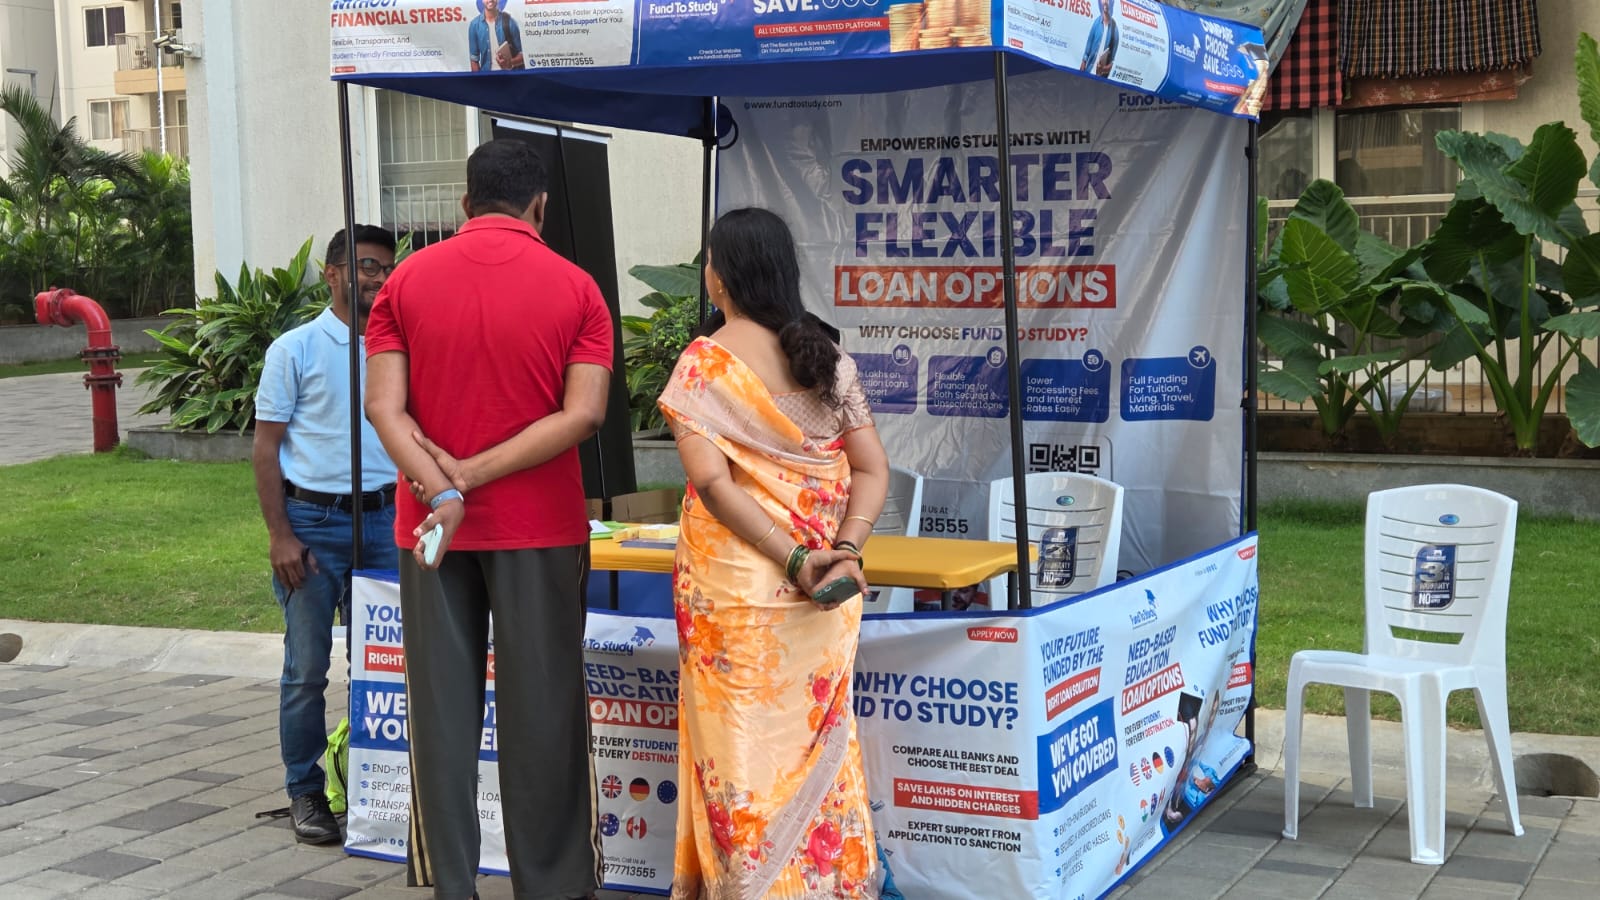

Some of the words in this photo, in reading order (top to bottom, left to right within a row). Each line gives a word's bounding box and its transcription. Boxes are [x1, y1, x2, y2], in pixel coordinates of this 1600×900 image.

[573, 9, 591, 17] Faster
[649, 3, 674, 15] Fund
[675, 1, 688, 13] To
[688, 0, 719, 15] Study
[753, 0, 820, 14] SAVE.
[331, 9, 408, 28] FINANCIAL
[409, 6, 467, 25] STRESS.
[538, 18, 573, 27] End-To-End
[574, 17, 598, 27] Support
[610, 16, 623, 24] Your
[525, 29, 541, 38] Study
[543, 28, 565, 36] Abroad
[758, 27, 769, 35] ALL
[799, 23, 814, 32] ONE
[815, 21, 844, 31] TRUSTED
[845, 19, 883, 29] PLATFORM.
[382, 50, 412, 58] Financial
[537, 58, 550, 67] +91
[551, 56, 595, 67] 8977713555
[751, 99, 842, 110] www.fundtostudy.com
[860, 135, 960, 152] EMPOWERING
[1047, 129, 1091, 145] WITH
[841, 151, 1112, 205] SMARTER
[855, 208, 1098, 258] FLEXIBLE
[840, 271, 938, 301] LOAN
[858, 325, 896, 341] WHY
[897, 326, 960, 341] CHOOSE
[962, 327, 1003, 341] FUND
[1028, 326, 1089, 342] STUDY?
[934, 381, 975, 392] Financing
[1027, 376, 1054, 385] Lower
[1129, 376, 1146, 385] Full
[1147, 374, 1188, 386] Funding
[934, 390, 954, 399] Both
[955, 391, 988, 400] Secured
[1026, 385, 1079, 397] Processing
[1079, 386, 1099, 396] Fees
[1129, 385, 1144, 395] For
[1147, 384, 1182, 395] Tuition,
[934, 400, 978, 410] Unsecured
[979, 401, 1004, 410] Loans
[1026, 395, 1045, 404] and
[1047, 394, 1082, 404] Interest
[1161, 393, 1194, 403] Travel,
[1026, 404, 1053, 413] Rates
[1055, 404, 1081, 415] Easily
[1129, 402, 1175, 414] Materials
[928, 506, 938, 514] Us
[939, 505, 948, 514] At
[1420, 561, 1445, 583] 3
[1418, 592, 1431, 605] NO
[1206, 598, 1235, 624] WHY
[970, 631, 994, 639] APPLY
[994, 632, 1016, 640] NOW
[1198, 622, 1230, 649] FUND
[589, 638, 601, 650] To
[601, 640, 633, 656] Study
[1041, 638, 1062, 663] YOUR
[1063, 626, 1100, 654] FUTURE
[1128, 625, 1177, 664] NEED-BASED
[368, 652, 404, 666] RIGHT
[1042, 655, 1072, 687] FUNDED
[1072, 650, 1087, 672] BY
[1087, 644, 1105, 667] THE
[1125, 648, 1171, 687] EDUCATION
[853, 671, 907, 695] WHY
[909, 674, 1019, 704] CHOOSE
[1060, 689, 1073, 707] LOAN
[1072, 674, 1099, 701] SOLUTION
[1122, 684, 1146, 713] LOAN
[1145, 665, 1183, 703] OPTIONS
[590, 699, 642, 724] OAN
[880, 698, 913, 722] TO
[917, 701, 1019, 731] STUDY?
[599, 735, 632, 748] EVERY
[1050, 733, 1080, 769] WE'VE
[1080, 715, 1099, 744] GOT
[598, 750, 631, 760] EVERY
[892, 744, 942, 757] COMPARE
[943, 750, 960, 760] ALL
[961, 751, 995, 763] BANKS
[996, 754, 1020, 765] AND
[907, 757, 949, 769] CHOOSE
[950, 761, 968, 772] THE
[969, 763, 993, 774] BEST
[994, 765, 1020, 777] DEAL
[1051, 766, 1073, 798] YOU
[1073, 737, 1116, 784] COVERED
[897, 783, 924, 793] SAVE
[924, 785, 957, 797] LAKHS
[959, 788, 973, 798] ON
[974, 790, 1021, 804] INTEREST
[911, 795, 933, 806] AND
[934, 797, 972, 811] HIDDEN
[972, 801, 1022, 815] CHARGES
[368, 810, 388, 821] FREE
[908, 820, 944, 834] EXPERT
[945, 824, 991, 839] SUPPORT
[992, 829, 1022, 842] FROM
[888, 829, 952, 846] APPLICATION
[954, 836, 968, 847] TO
[969, 838, 1022, 853] SANCTION
[603, 863, 657, 879] 977713555
